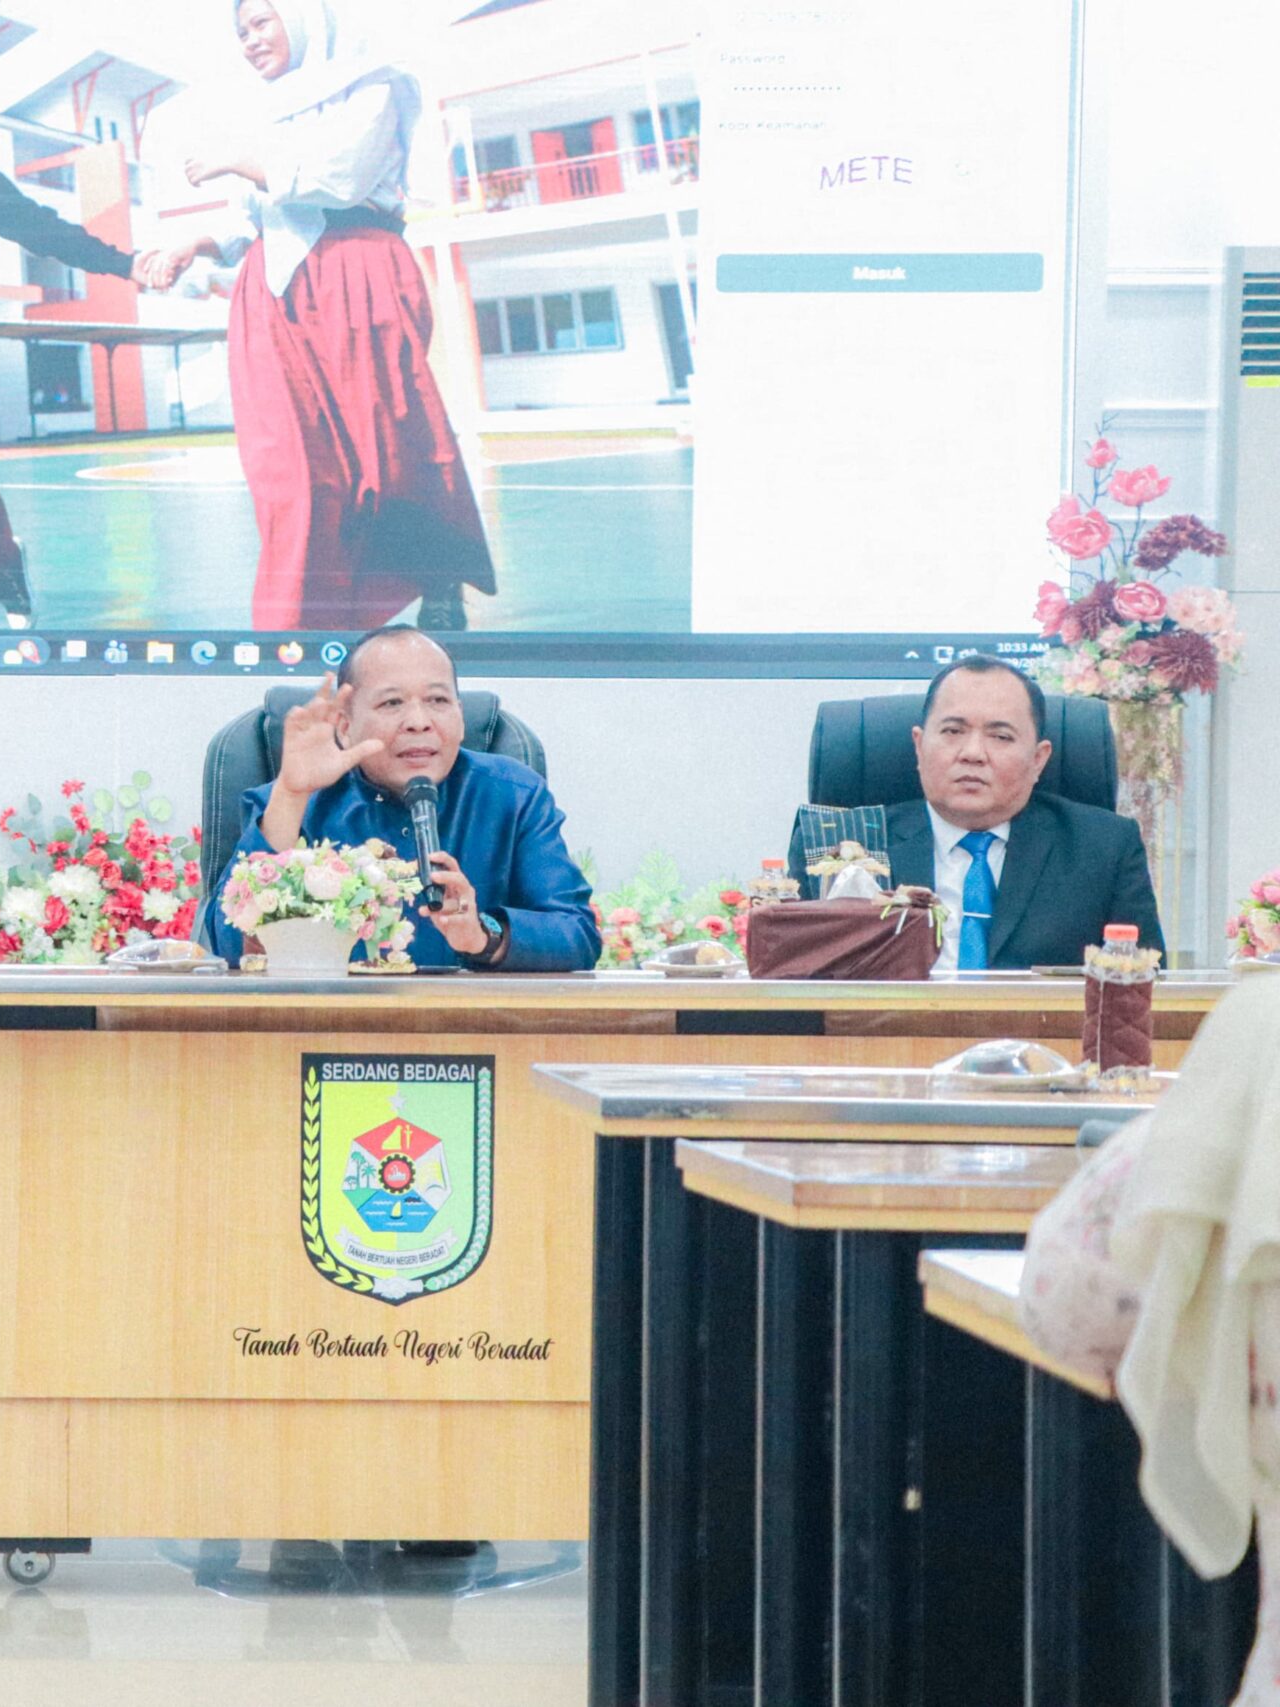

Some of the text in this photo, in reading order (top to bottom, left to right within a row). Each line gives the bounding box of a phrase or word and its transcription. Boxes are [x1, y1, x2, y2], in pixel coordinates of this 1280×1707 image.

[852, 266, 907, 281] Masuk
[1030, 642, 1050, 653] AM
[321, 1062, 475, 1081] SERDANG BEDAGAI
[347, 1244, 445, 1265] TANAH BERTUAH NEGERI BERADAT
[232, 1326, 556, 1366] Tanah Bertuah Negeri Beradat
